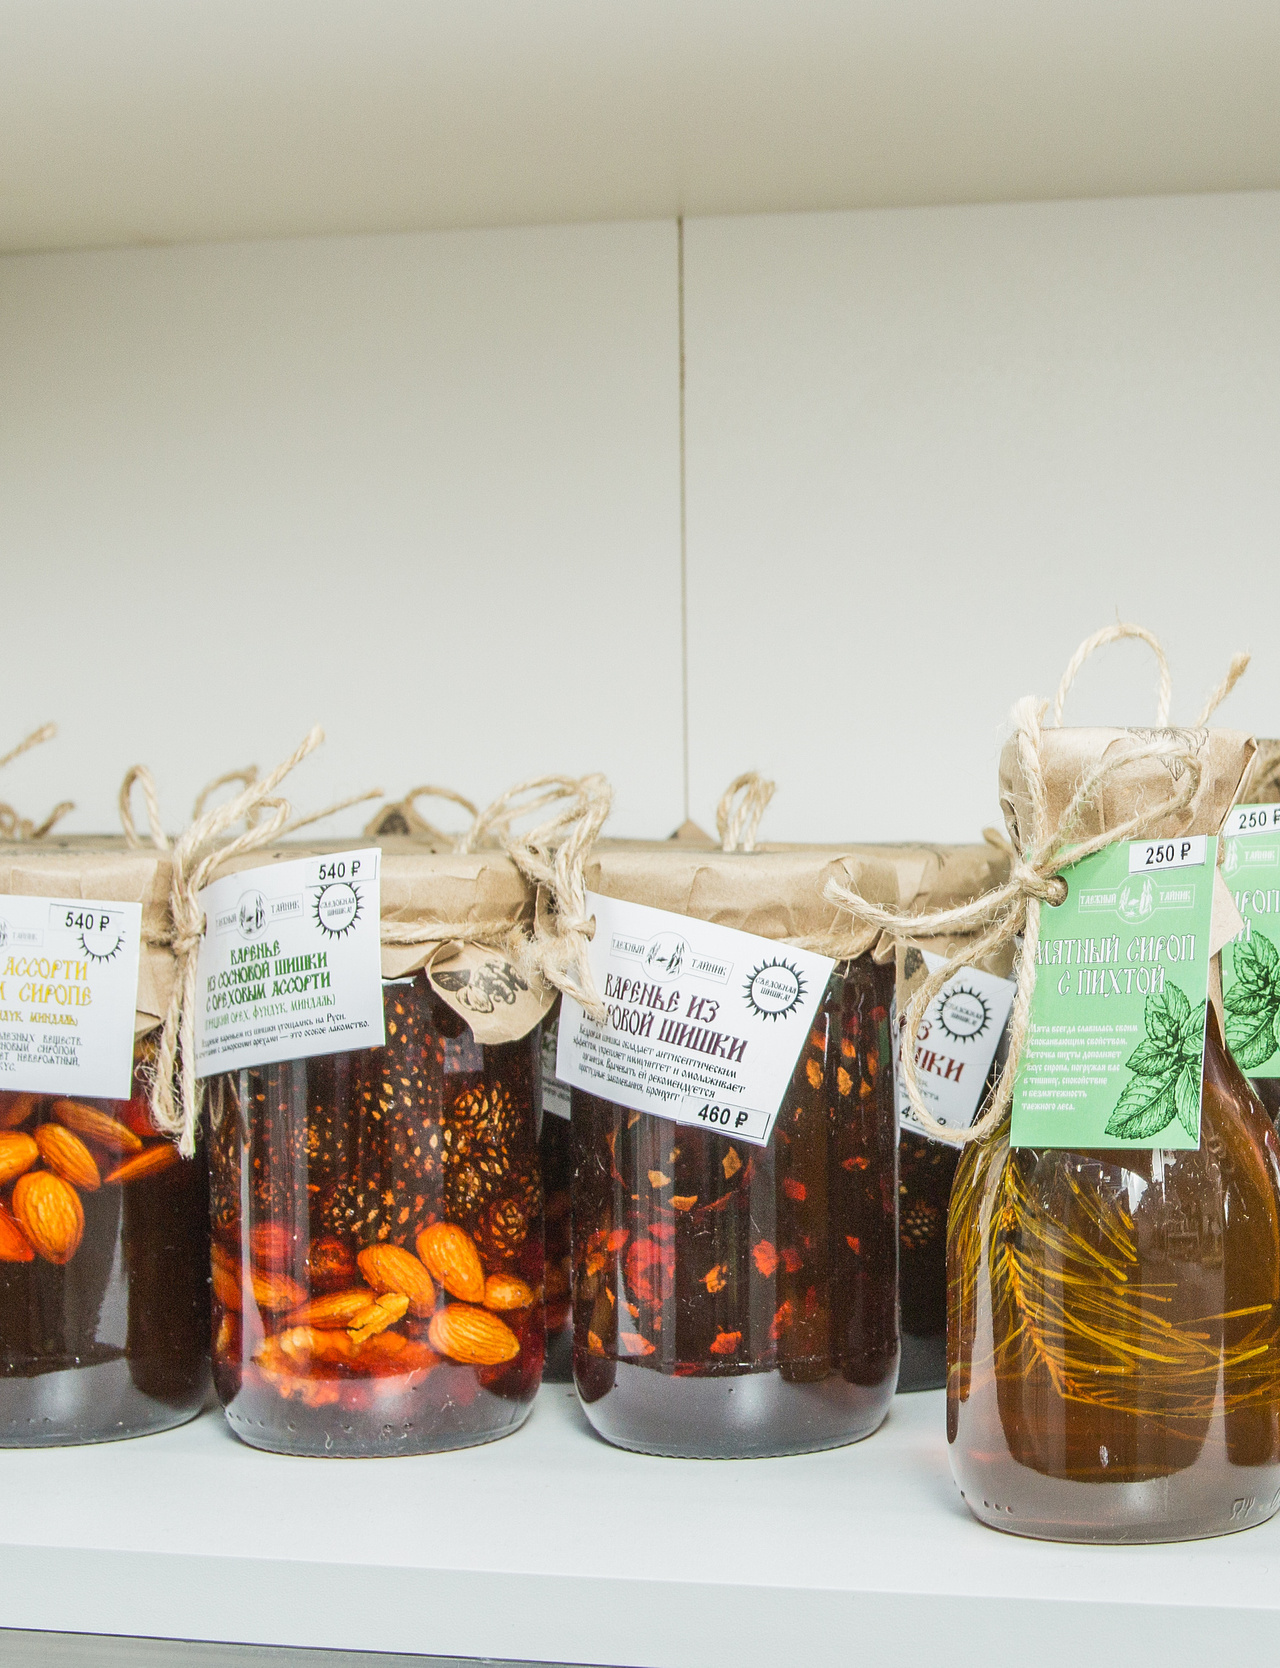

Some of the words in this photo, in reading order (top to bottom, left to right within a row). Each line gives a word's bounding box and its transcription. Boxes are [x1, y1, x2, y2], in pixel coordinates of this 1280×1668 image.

[1238, 810, 1267, 830] 250
[1145, 844, 1175, 866] 250
[318, 862, 345, 880] 540
[1159, 890, 1191, 903] ТАЙНИК
[65, 911, 94, 930] 540
[230, 940, 281, 965] ВАРЕНЬЕ
[1037, 933, 1120, 966] МЯТНЫЙ
[1126, 933, 1196, 963] СИРОП
[2, 956, 88, 981] АССОРТИ
[207, 975, 216, 992] ИЗ
[217, 960, 270, 988] СОСНОВОЙ
[274, 952, 327, 976] ШИШКИ
[691, 958, 727, 976] ТАЙНИК
[206, 996, 211, 1012] С
[212, 983, 266, 1011] ОРЕХОВЫМ
[271, 971, 331, 997] АССОРТИ
[1057, 970, 1071, 996] С
[1077, 965, 1166, 998] ПИХТОЙ
[18, 981, 93, 1006] СИРОПЕ
[291, 994, 335, 1011] МИНДАЛЬ)
[604, 973, 680, 1012] ВАРЕНЬЕ
[685, 995, 720, 1023] ИЗ
[326, 1012, 346, 1024] Руси.
[328, 1020, 369, 1033] лакомство.
[1051, 1025, 1076, 1035] всегда
[657, 1019, 747, 1063] ШИШКИ
[655, 1050, 736, 1078] антисептическим
[1082, 1051, 1122, 1061] дополняет
[1071, 1063, 1106, 1075] погружая
[1107, 1063, 1121, 1073] вас
[637, 1070, 647, 1079] ей
[647, 1073, 715, 1101] рекомендуется
[681, 1069, 746, 1093] омолаживает
[1062, 1075, 1108, 1086] спокойствие
[645, 1086, 680, 1102] бронхит
[697, 1104, 731, 1125] 460
